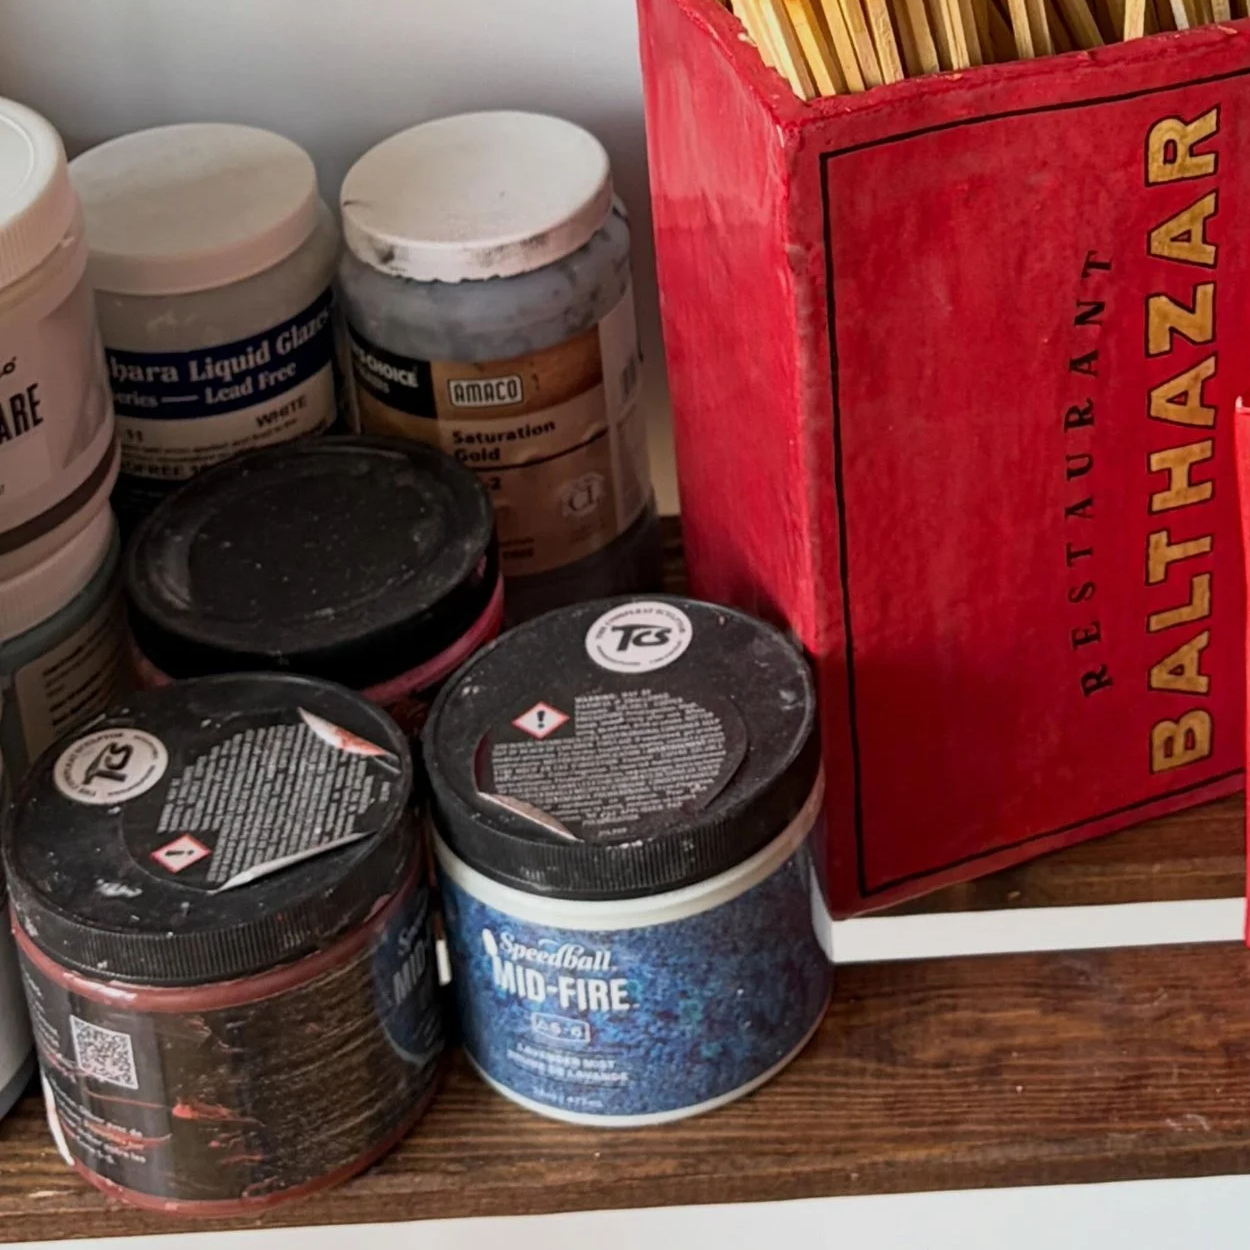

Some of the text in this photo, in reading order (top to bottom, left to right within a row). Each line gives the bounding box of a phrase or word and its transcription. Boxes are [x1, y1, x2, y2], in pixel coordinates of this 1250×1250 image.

[187, 339, 271, 383] Liquid
[205, 362, 298, 406] Lead Free
[454, 379, 519, 403] AMACO
[256, 395, 308, 429] WHITE
[452, 420, 556, 445] Saturation
[454, 447, 501, 463] Gold
[1145, 103, 1222, 774] BALTHAZAR
[1064, 251, 1112, 697] RESTAURANT
[611, 624, 672, 652] TCS
[499, 930, 613, 972] Speedball
[491, 954, 632, 1012] MID-FIRE
